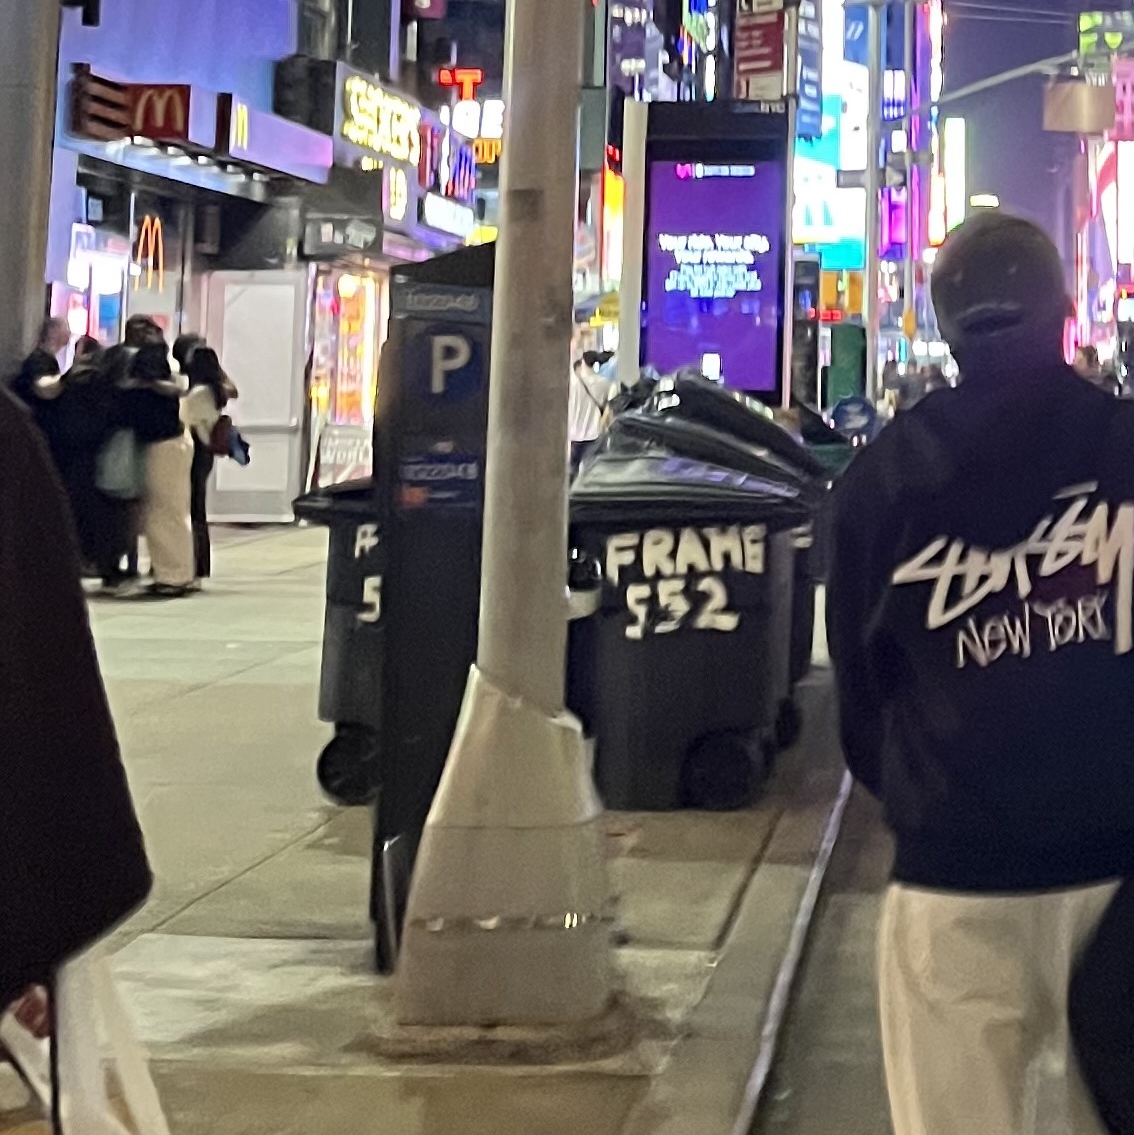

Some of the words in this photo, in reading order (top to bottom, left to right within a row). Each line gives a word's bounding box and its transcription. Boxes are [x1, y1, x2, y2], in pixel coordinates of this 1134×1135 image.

[430, 334, 471, 394] P
[606, 523, 767, 586] FRAME
[625, 576, 740, 639] 552
